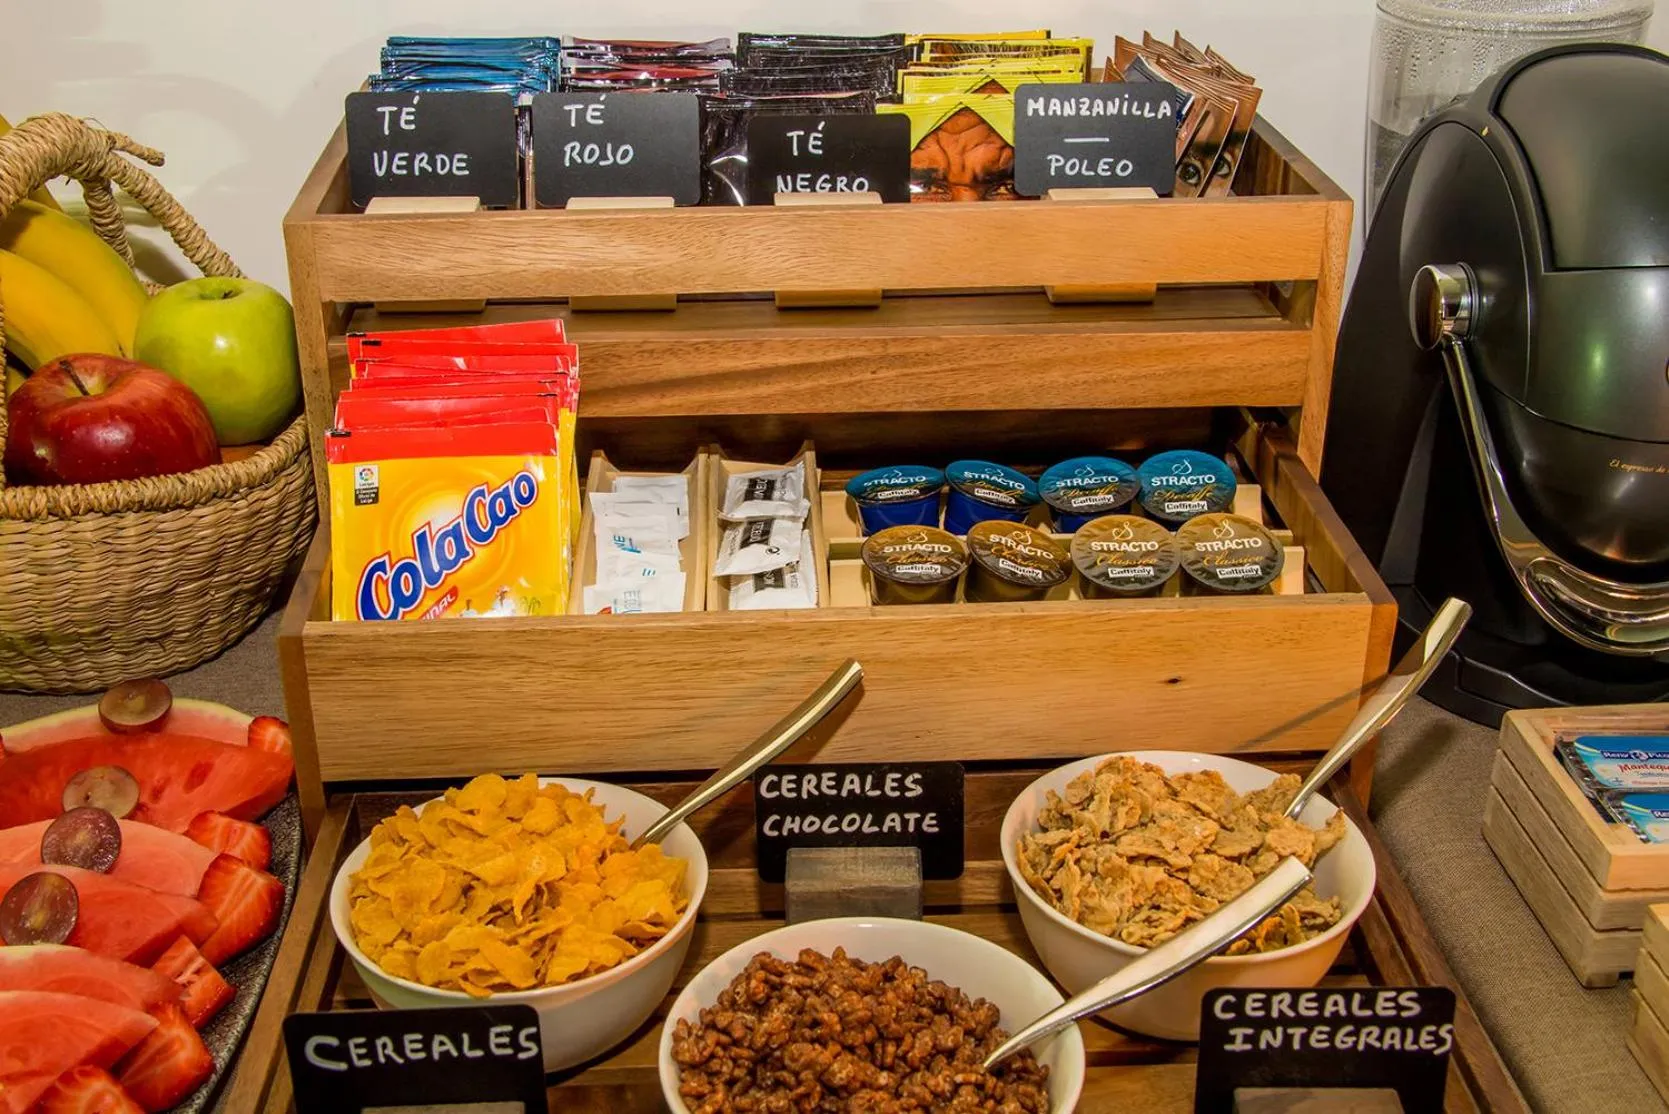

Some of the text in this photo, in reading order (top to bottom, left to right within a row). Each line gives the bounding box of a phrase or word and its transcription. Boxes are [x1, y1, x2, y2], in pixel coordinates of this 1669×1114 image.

[376, 95, 420, 135] TÉ
[563, 94, 608, 128] TÉ
[786, 121, 826, 156] TÉ
[373, 151, 471, 177] VERDE
[563, 141, 635, 167] ROJO
[1047, 154, 1134, 177] POLEO
[776, 173, 869, 193] NEGRO
[863, 475, 927, 487] STRACTO
[963, 471, 1026, 490] STRACTO
[1055, 475, 1119, 488] STRACTO
[1151, 474, 1216, 487] STRACTO
[884, 542, 952, 553] STRACTO
[989, 533, 1054, 560] STRACTO
[1091, 540, 1159, 552] STRACTO
[1194, 537, 1263, 552] STRACTO
[760, 771, 924, 799] CEREALES
[762, 812, 940, 837] CHOCOLATE
[1213, 990, 1422, 1020] CEREALES
[304, 1025, 539, 1071] CEREALES
[1223, 1023, 1455, 1056] INTEGRALES
